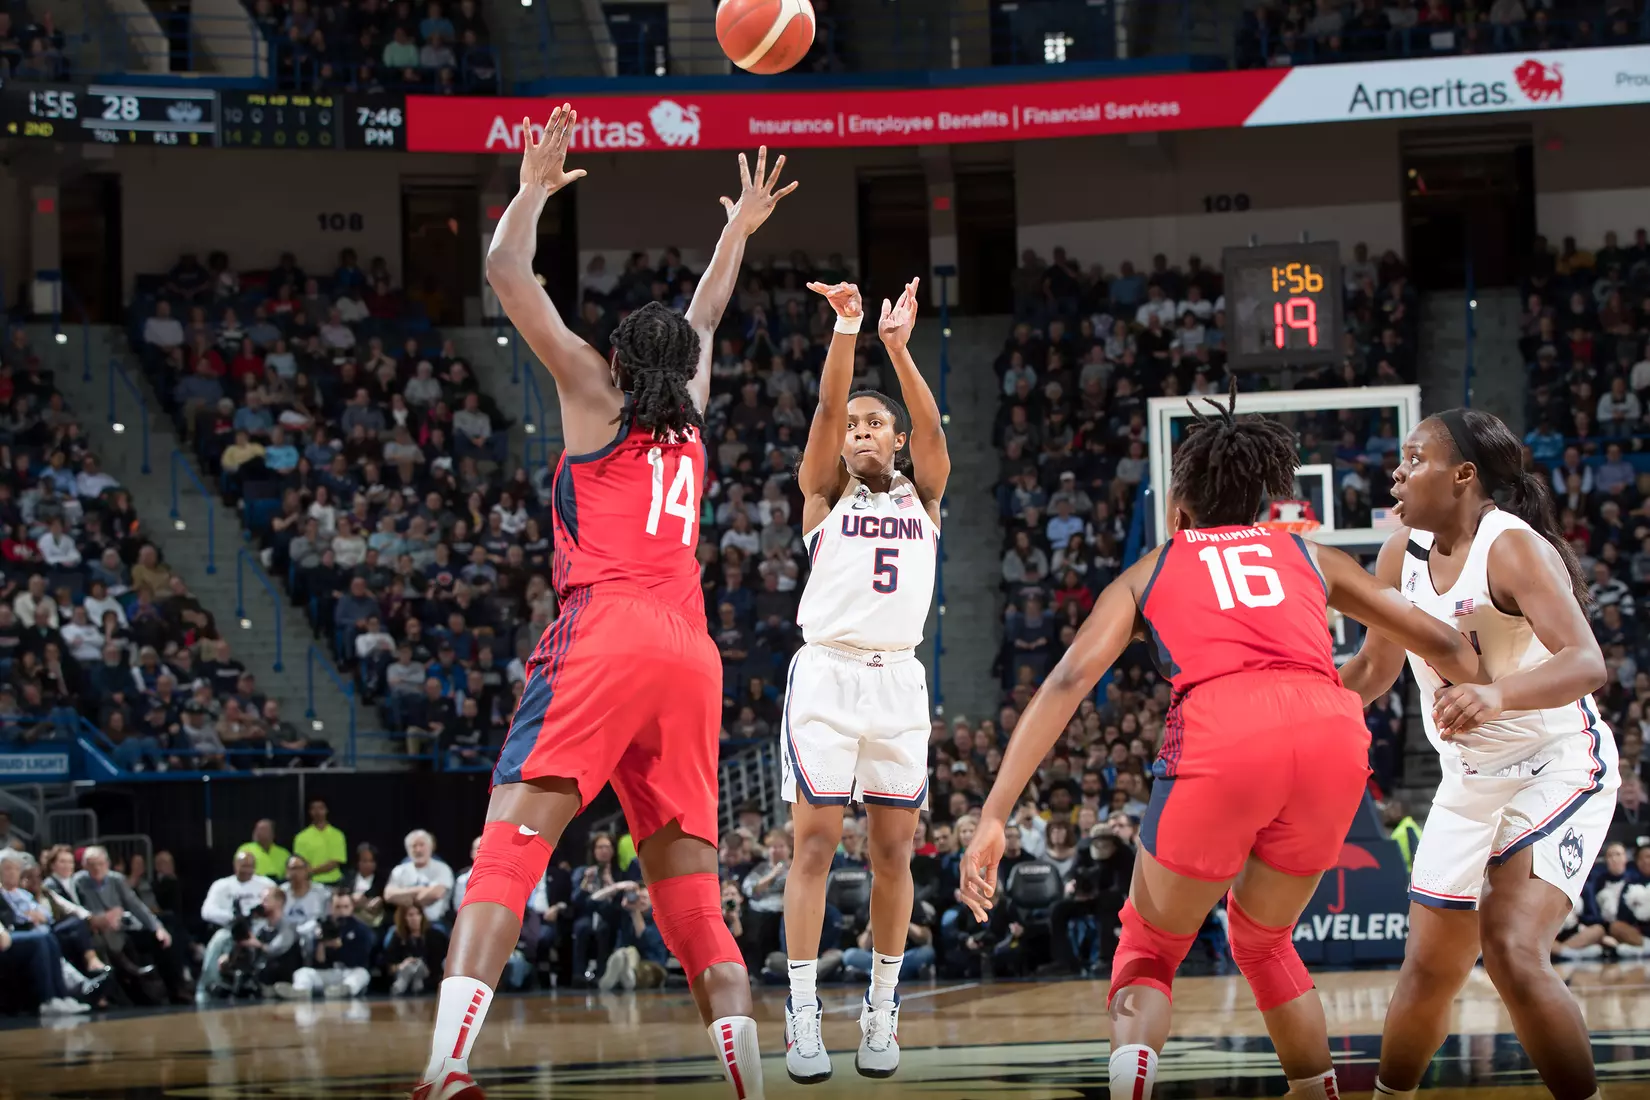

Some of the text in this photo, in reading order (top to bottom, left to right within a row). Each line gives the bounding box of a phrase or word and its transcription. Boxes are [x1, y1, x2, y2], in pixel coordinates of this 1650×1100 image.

[29, 90, 77, 119] 1:56
[102, 96, 140, 121] 28
[1348, 80, 1508, 114] Ameritas
[24, 121, 54, 137] 2ND
[356, 107, 402, 127] 7:46
[749, 99, 1180, 135] Insurance Employee Benefits Financial Services
[365, 128, 394, 146] PM
[1203, 193, 1250, 213] 109
[317, 212, 364, 232] 108
[1271, 262, 1324, 294] 1:56
[1273, 296, 1318, 349] 19
[646, 446, 696, 546] 14
[841, 514, 924, 540] UCONN
[872, 547, 900, 594] 5
[1198, 543, 1286, 611] 16
